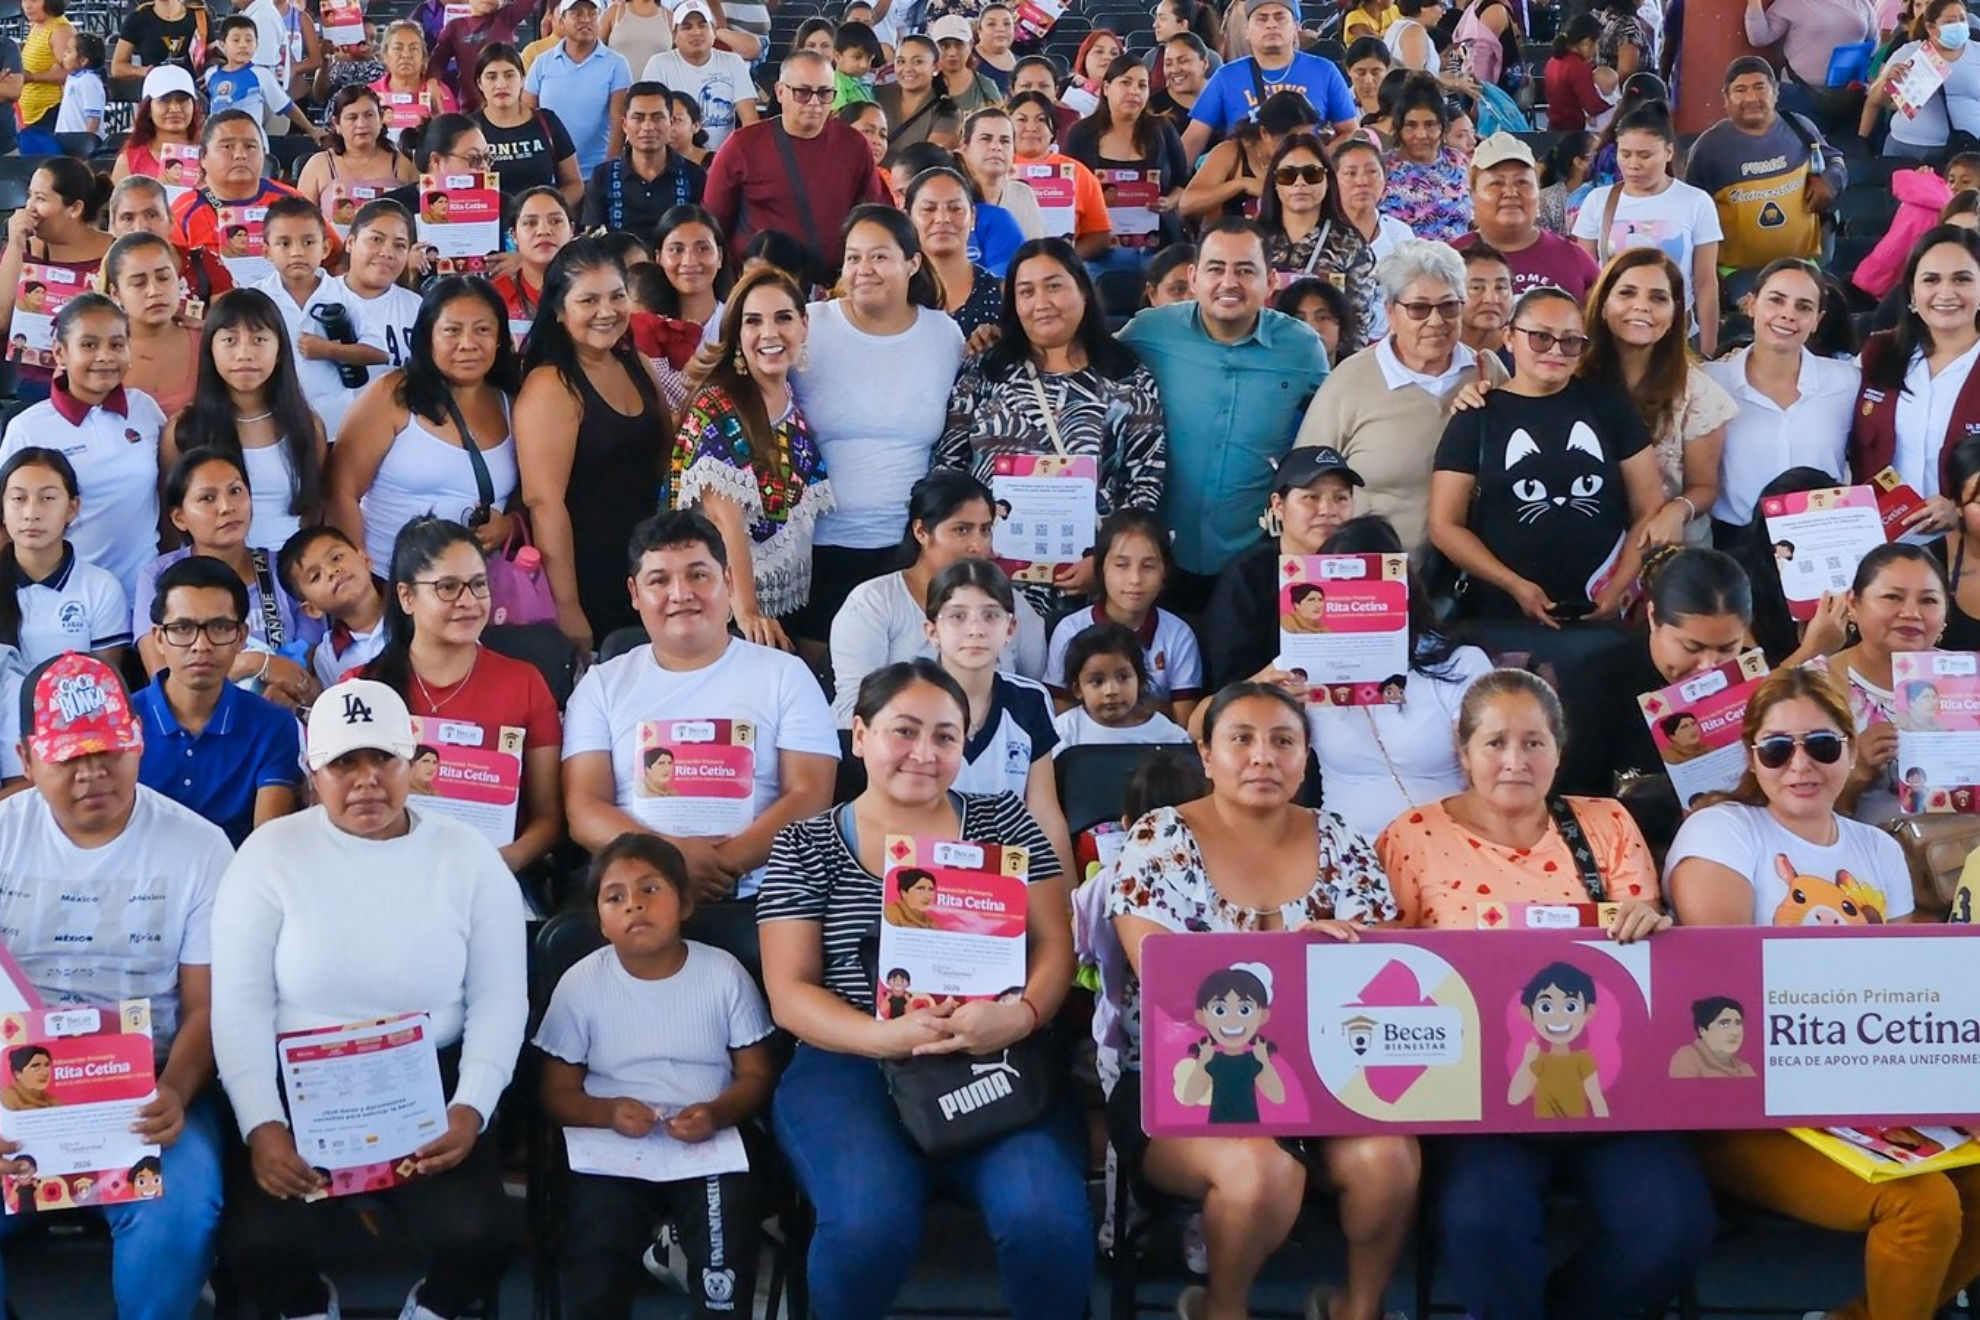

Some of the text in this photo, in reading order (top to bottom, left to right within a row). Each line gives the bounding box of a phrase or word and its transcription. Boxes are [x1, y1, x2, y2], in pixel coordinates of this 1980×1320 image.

[1326, 600, 1388, 613] Rita Cetina
[342, 693, 373, 724] LA
[1940, 698, 1962, 711] Rita
[1700, 716, 1726, 734] Rita
[439, 766, 463, 778] Rita
[463, 769, 501, 784] Cetina
[675, 765, 737, 777] Rita Cetina
[936, 893, 1007, 912] Rita Cetina
[1768, 987, 1941, 1005] Educación Primaria
[1383, 1023, 1447, 1042] Becas
[1769, 1010, 1980, 1046] Rita Cetina
[1384, 1042, 1446, 1052] BIENESTAR
[1769, 1056, 1802, 1067] BECA
[1804, 1055, 1821, 1067] DE
[1824, 1055, 1869, 1066] APOYO
[1872, 1054, 1907, 1065] PARA
[54, 1065, 84, 1080] Rita
[84, 1061, 131, 1076] Cetina
[938, 1071, 1013, 1121] PUMA
